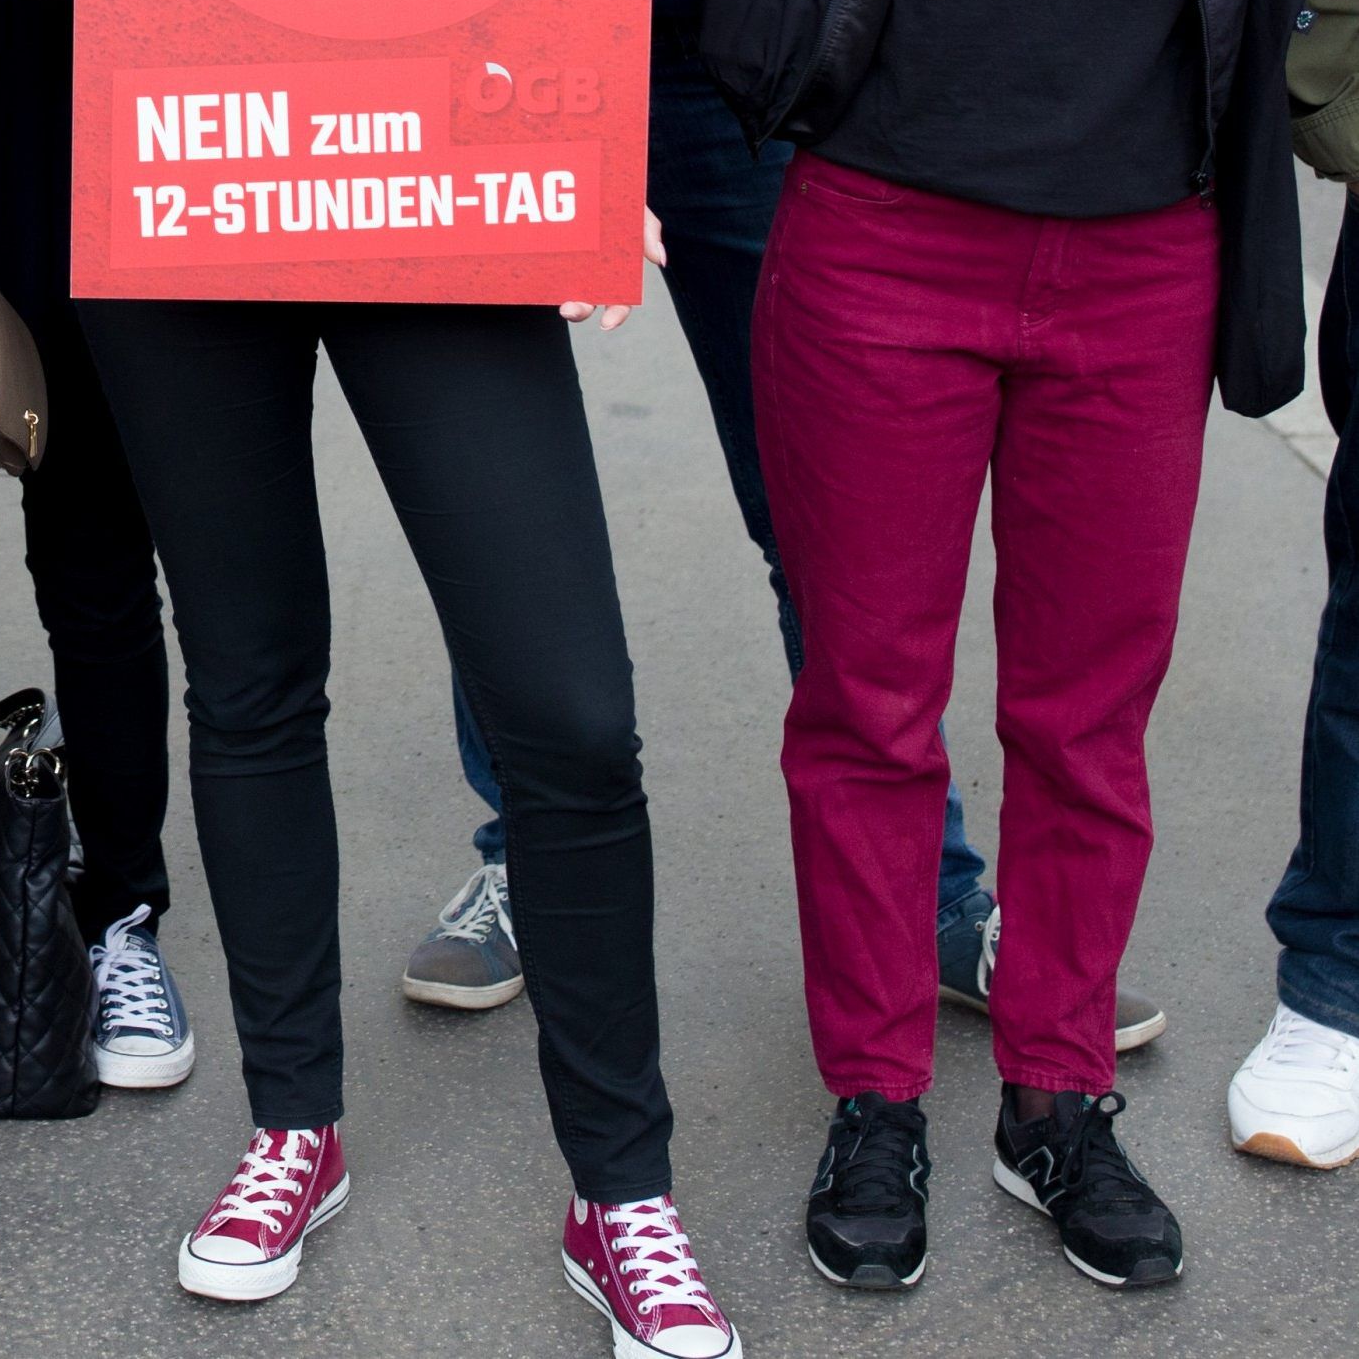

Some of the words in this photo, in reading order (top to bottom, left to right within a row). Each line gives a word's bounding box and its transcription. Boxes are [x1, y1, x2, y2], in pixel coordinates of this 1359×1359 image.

[136, 91, 290, 162] NEIN
[311, 111, 422, 156] zum
[134, 170, 576, 238] 12-STUNDEN-TAG
